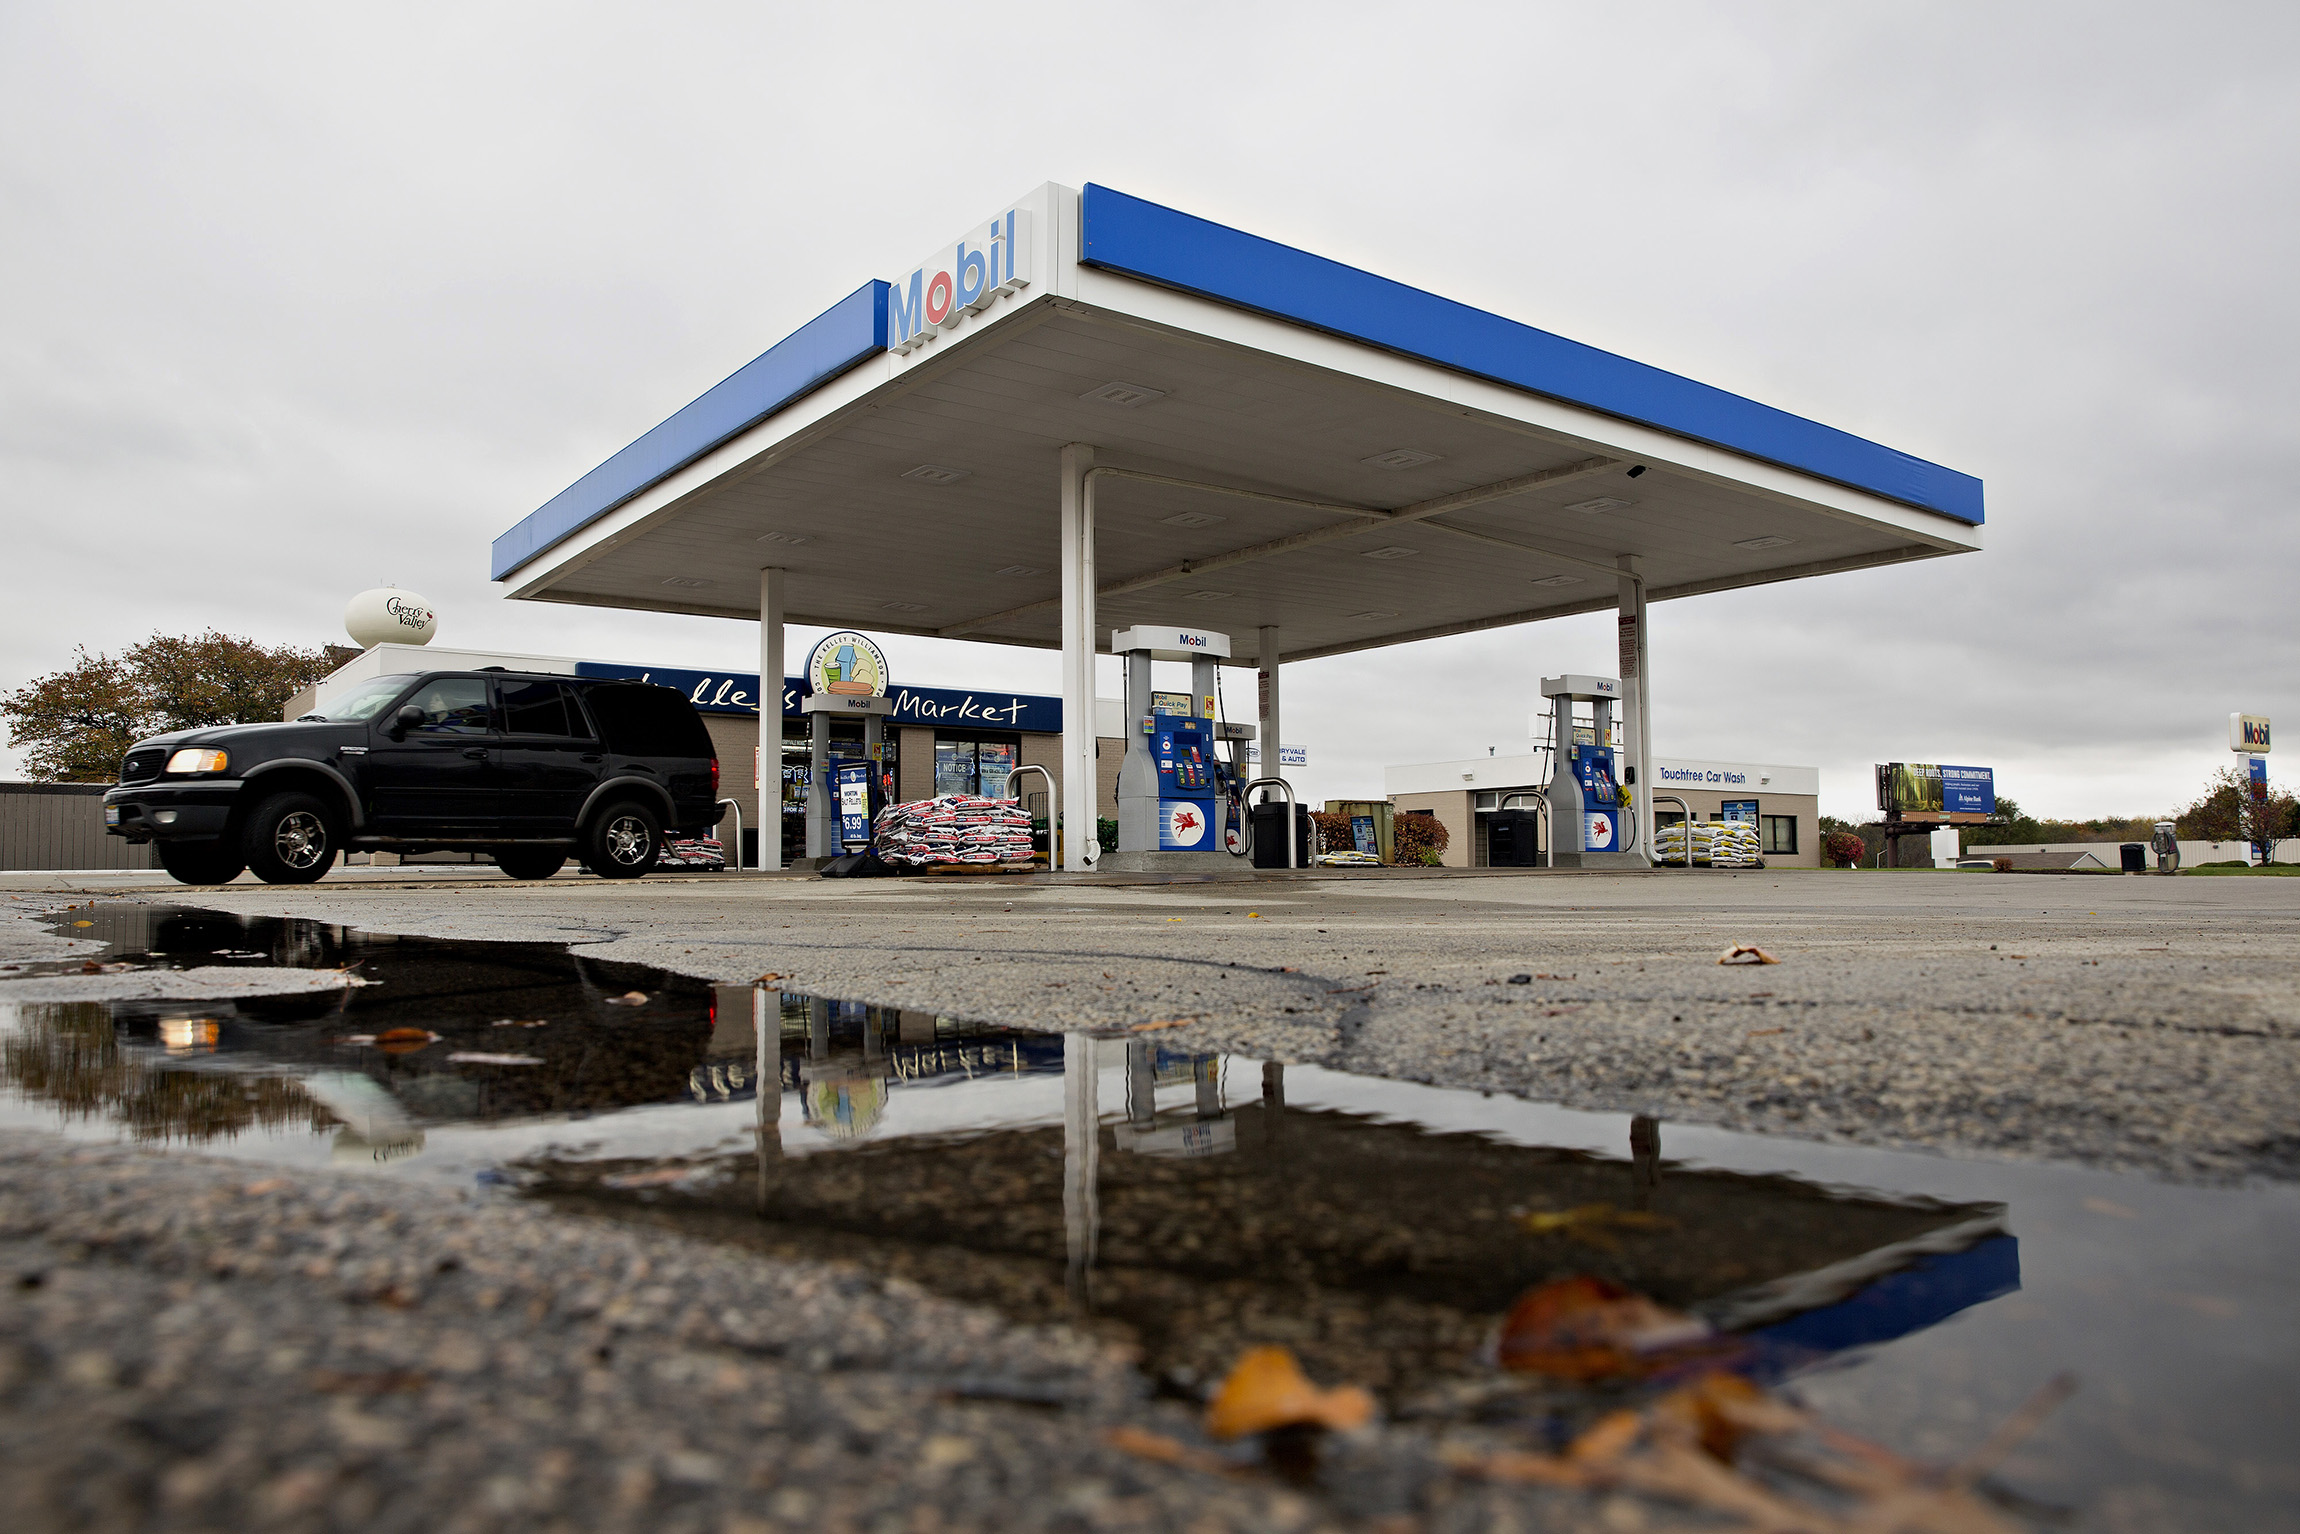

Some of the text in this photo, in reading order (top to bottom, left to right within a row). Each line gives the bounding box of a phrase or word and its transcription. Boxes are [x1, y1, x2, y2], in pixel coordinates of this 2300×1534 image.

[888, 208, 1020, 353] Mobil
[386, 597, 424, 618] Cherry
[399, 613, 430, 630] Valley
[1180, 634, 1207, 647] Mobil
[814, 637, 885, 675] THE KELLEY WILLIAMSON
[1597, 682, 1613, 692] Mobil
[848, 699, 871, 708] Mobil
[892, 689, 1028, 725] Market
[1226, 726, 1243, 735] Mobil
[2243, 721, 2270, 746] Mobil
[1279, 748, 1306, 756] RYVALE
[943, 763, 966, 773] NOTICE
[1942, 769, 1960, 778] STRONG
[1961, 770, 1992, 780] COMMITMENT.
[1660, 767, 1746, 784] Touchfree Car Wash
[842, 816, 862, 830] $6.99
